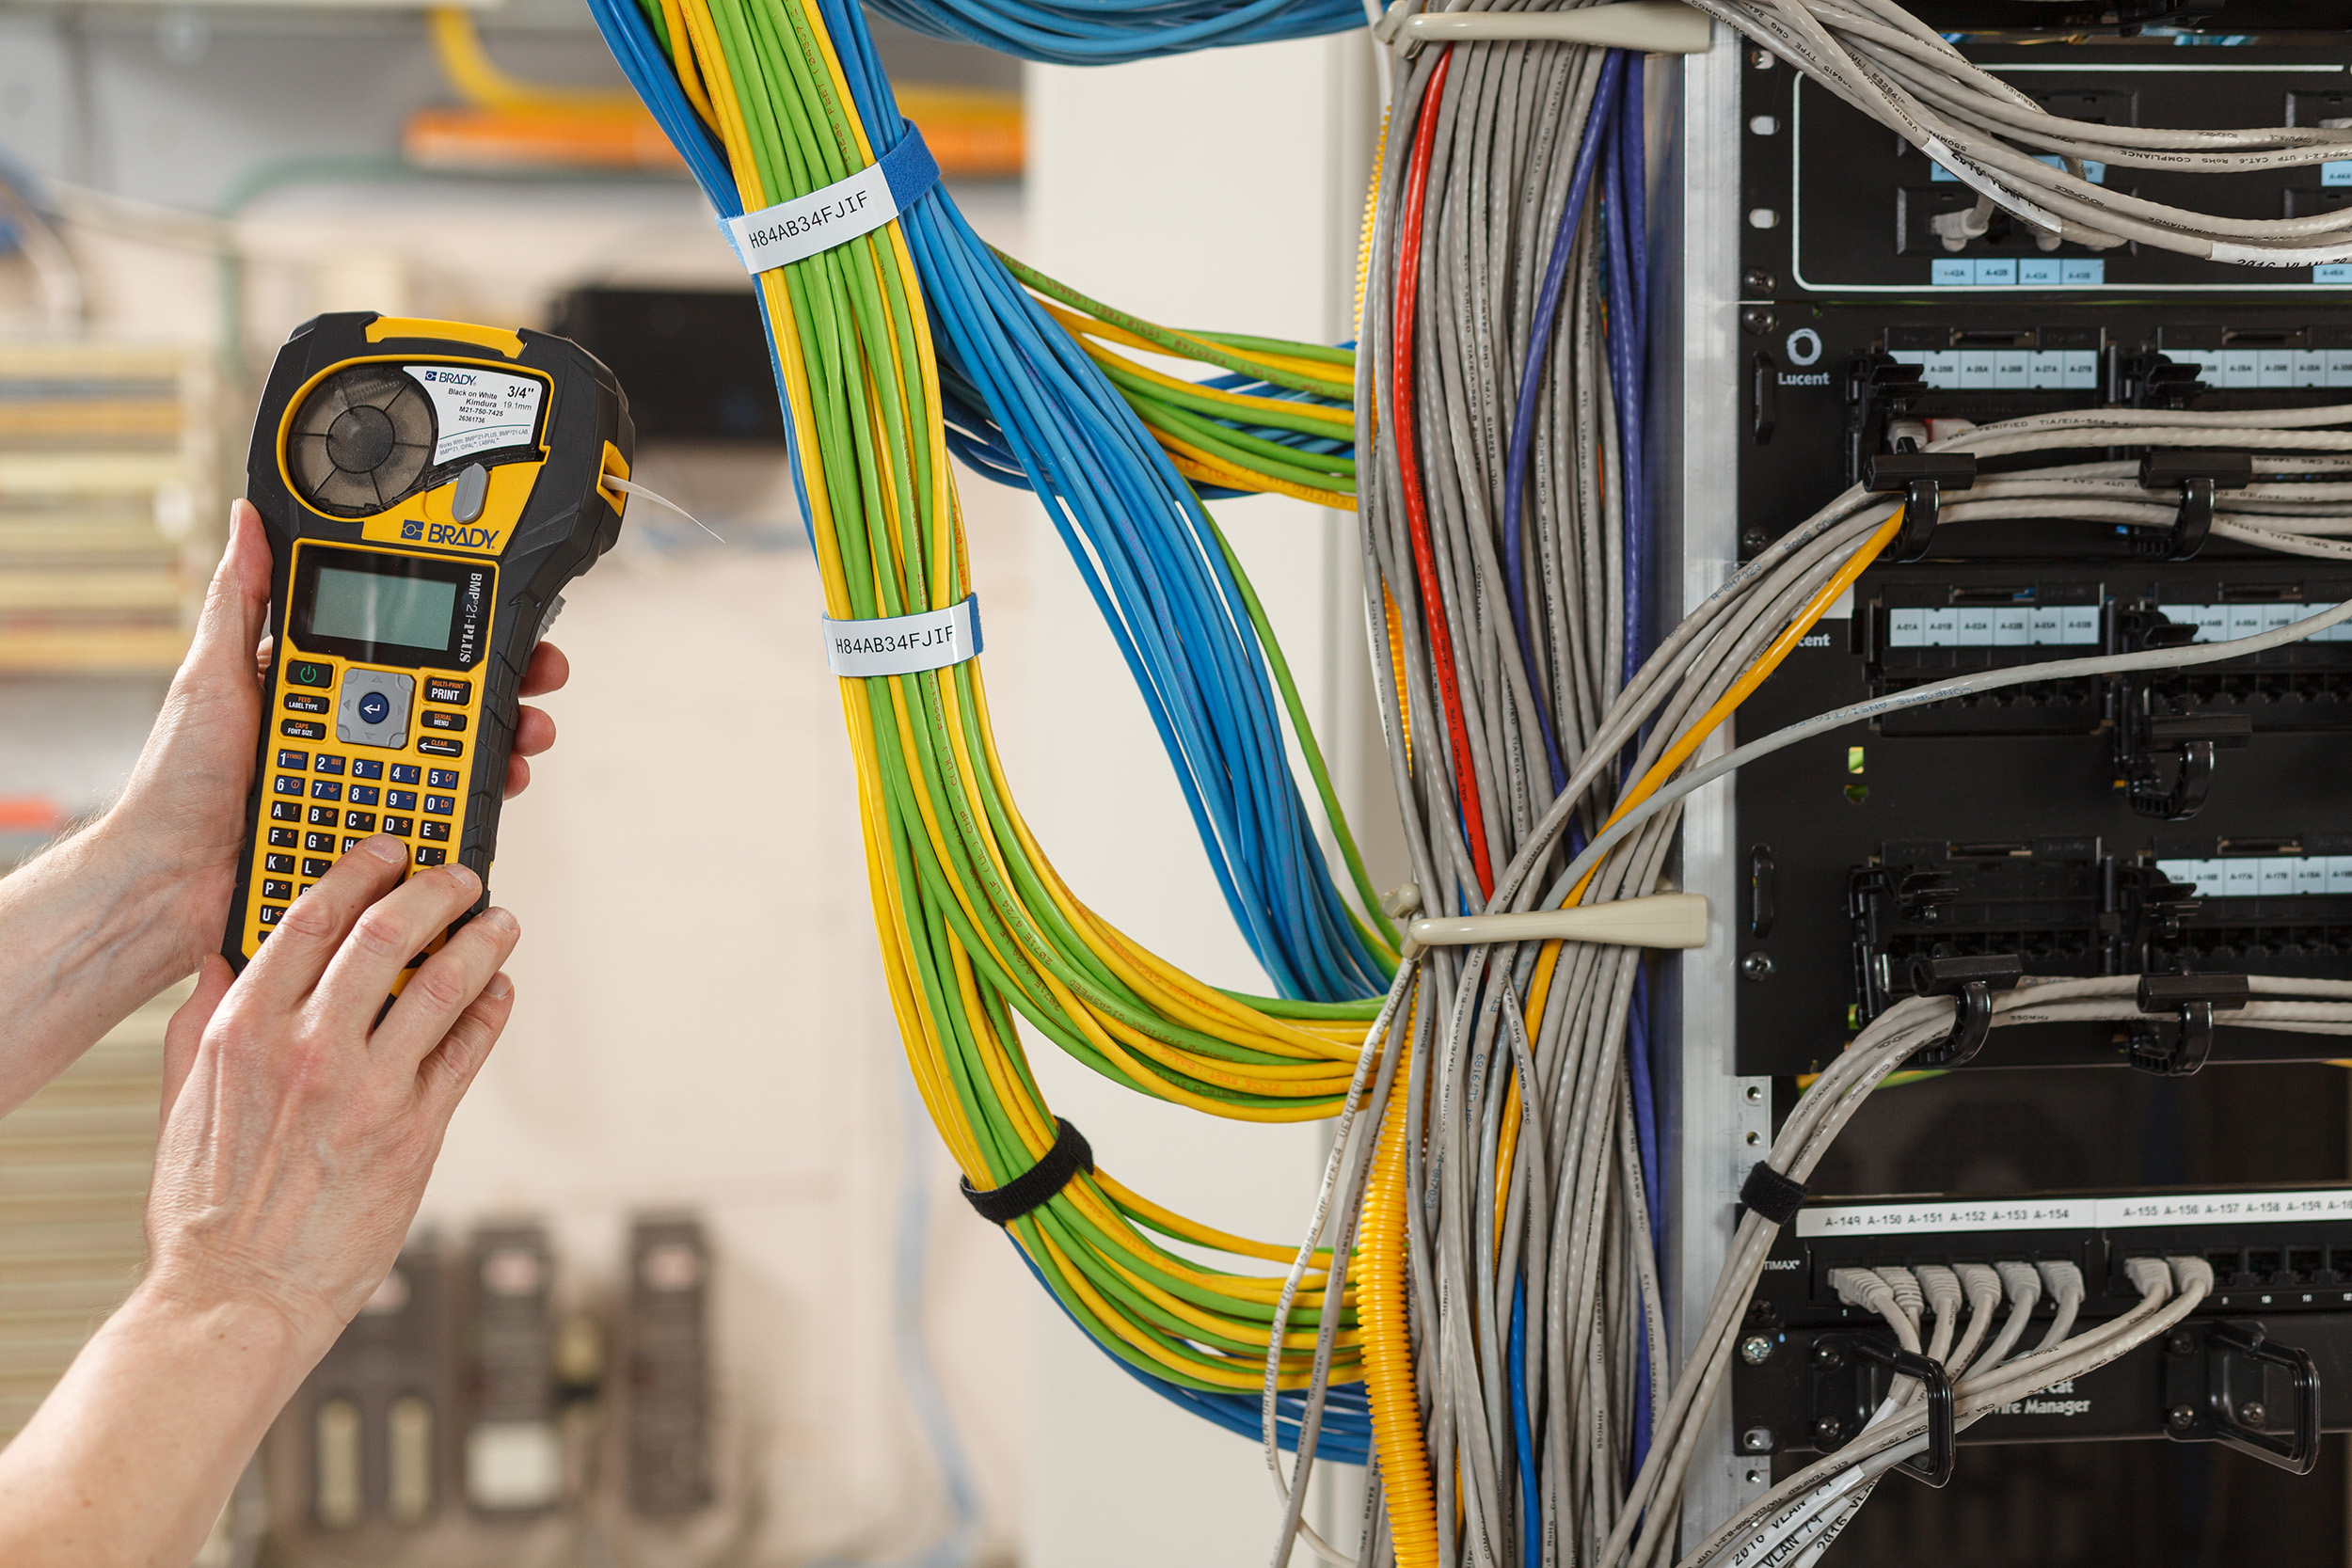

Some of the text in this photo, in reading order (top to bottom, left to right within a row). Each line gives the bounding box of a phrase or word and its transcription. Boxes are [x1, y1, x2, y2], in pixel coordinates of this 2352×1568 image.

[1771, 23, 1816, 62] TYPE CMG
[818, 83, 834, 116] FEET
[1882, 93, 1918, 133] VERIFIED
[2121, 150, 2191, 163] COMPLIANCE
[748, 190, 867, 249] H84AB34FJIF
[439, 372, 476, 386] BRADY
[1777, 372, 1830, 386] Lucent
[479, 391, 498, 400] White
[507, 386, 534, 399] 3/4"
[466, 398, 498, 408] Kimdura
[503, 401, 532, 411] 19.1mm
[459, 406, 503, 417] M21-750-7425
[458, 415, 485, 423] 26361736
[1978, 420, 2028, 432] VERIFIED
[438, 441, 453, 450] Works
[427, 523, 500, 549] BRADY
[1783, 531, 1812, 551] RoHS
[834, 625, 953, 655] H84AB34FJIF
[1799, 633, 1831, 647] cent
[431, 680, 465, 689] MULTI-PRINT
[1439, 638, 1457, 733] 24AWG CMG TYPE
[431, 688, 460, 701] PRINT
[305, 703, 318, 711] TYPE
[434, 713, 452, 721] SERIAL
[434, 719, 450, 727] MENU
[431, 739, 448, 748] CLEAR
[279, 752, 286, 766] 1
[317, 757, 325, 770] 2
[355, 762, 362, 774] 3
[392, 767, 400, 780] 4
[431, 771, 438, 784] 5
[277, 778, 284, 791] 6
[315, 783, 322, 796] 7
[352, 787, 359, 800] 8
[389, 792, 397, 805] 9
[427, 797, 435, 810] 0
[273, 804, 282, 817] A
[310, 809, 319, 821] B
[348, 814, 357, 826] C
[386, 818, 394, 832] D
[423, 823, 431, 836] E
[271, 830, 279, 843] F
[308, 835, 317, 847] G
[344, 840, 354, 852] H
[268, 856, 277, 869] K
[418, 849, 426, 863] J
[305, 861, 311, 874] L
[265, 882, 274, 895] P
[1502, 878, 1519, 902] RoHS
[262, 909, 271, 922] U
[960, 810, 1183, 1050] CMP LF 4/24 2071E GIGASPEED SYSTIMAX
[1472, 946, 1483, 968] UTP
[1000, 930, 1061, 1012] LF 4/24 2071E
[1419, 1017, 1431, 1055] 550MHz
[1339, 1079, 1364, 1138] VERIFIED
[1376, 973, 1408, 1036] CATEGORY
[1511, 1020, 1520, 1044] CMG
[1517, 1054, 1527, 1090] 24AWG
[1631, 1164, 1641, 1199] 24AWG
[2123, 1199, 2352, 1217] A-155 A-156 A-157 A-158 A-159 A-16
[1824, 1209, 2069, 1227] A-149 A-150 A-151 A-152 A-153 A-154
[1341, 1221, 1355, 1256] 24AWG
[1310, 1354, 1325, 1401] VERIFIED
[2024, 1399, 2091, 1416] Manager
[1906, 1424, 1927, 1436] CMG
[1831, 1460, 1850, 1470] ETL
[1788, 1471, 1827, 1496] VERIFIED
[1714, 1497, 1784, 1547] TIA/EIA-568-B.2-1
[1817, 1515, 1849, 1551] 2016
[1696, 1549, 1714, 1564] UTP
[1762, 1533, 1800, 1568] VLAN
